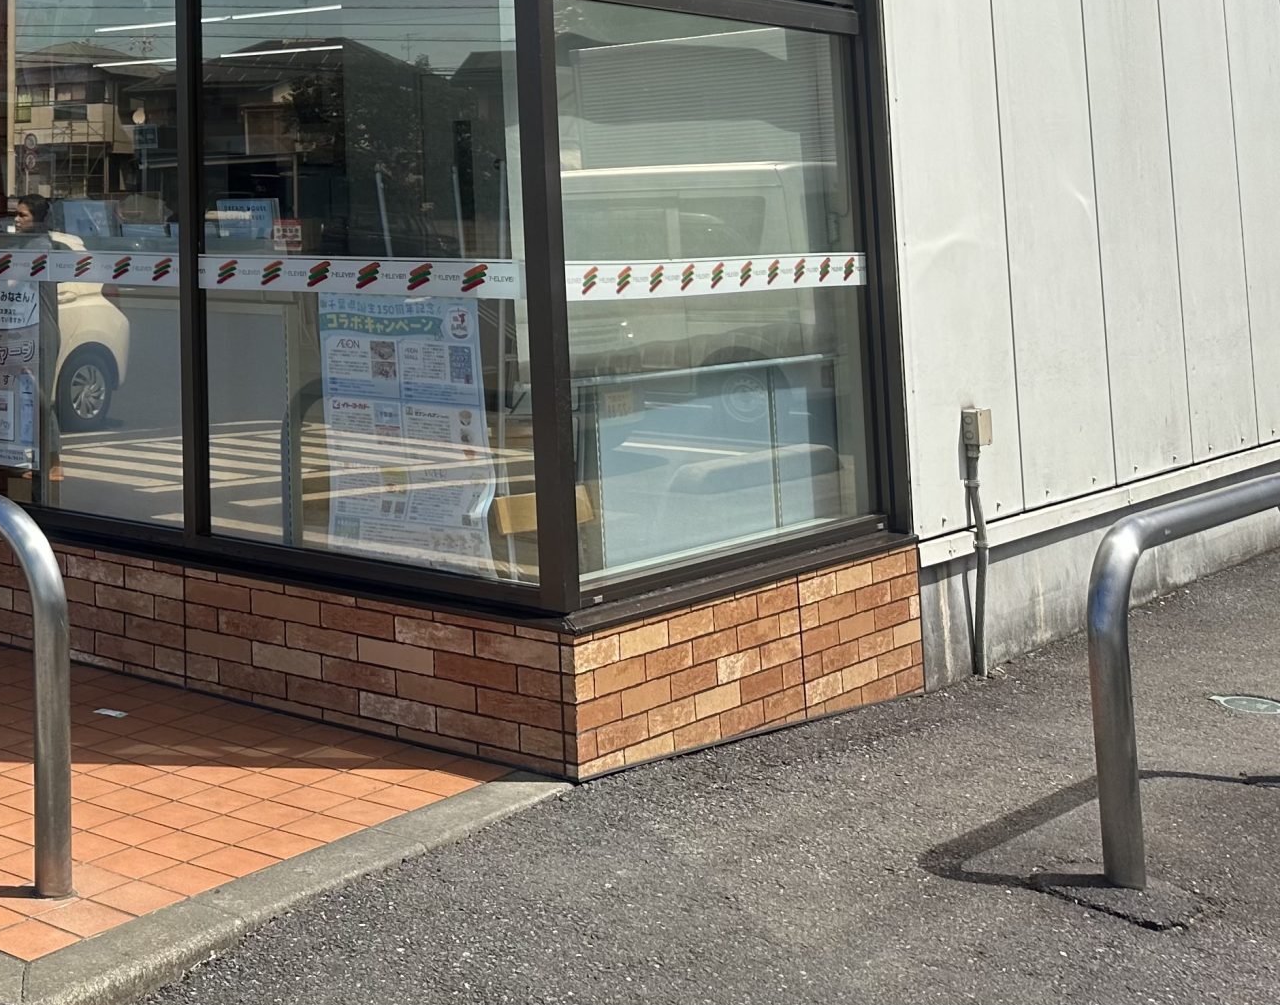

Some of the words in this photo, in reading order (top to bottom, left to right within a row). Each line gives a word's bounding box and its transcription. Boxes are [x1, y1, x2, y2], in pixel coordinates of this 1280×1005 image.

[327, 313, 434, 334] コラボキャンペーン
